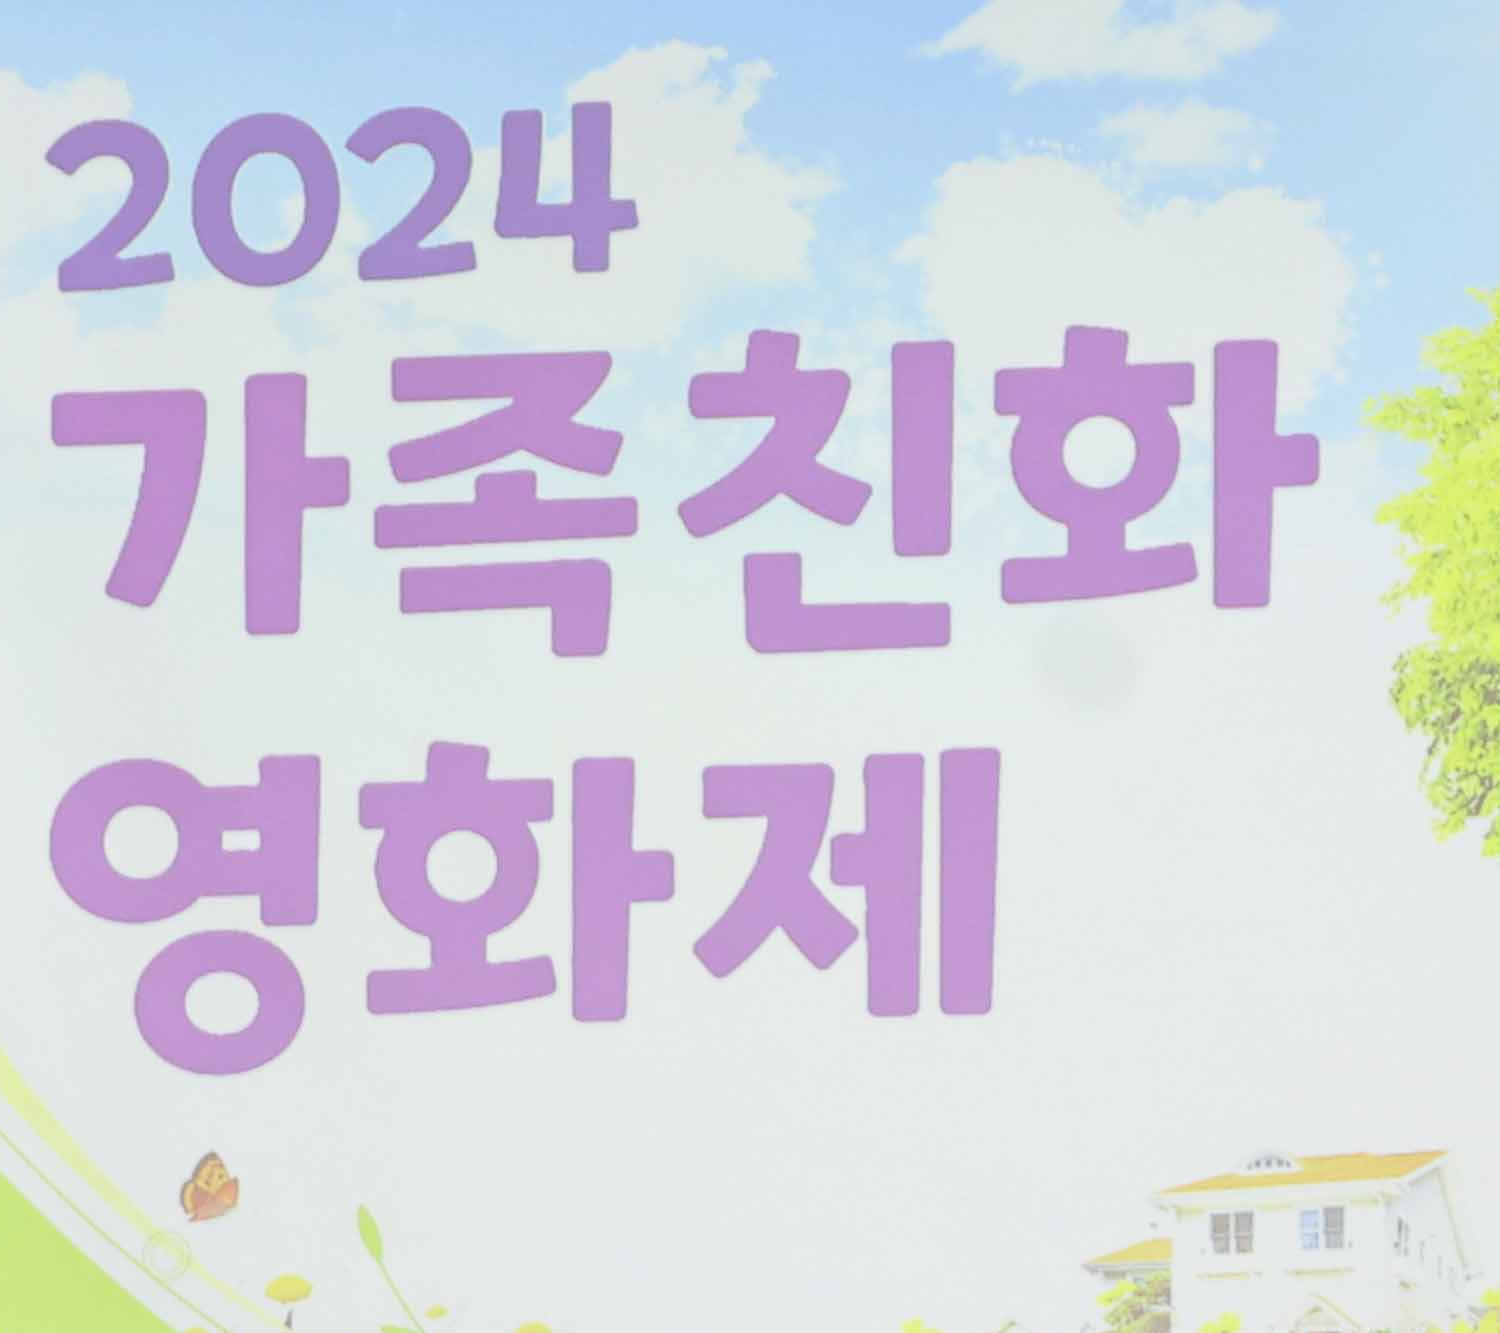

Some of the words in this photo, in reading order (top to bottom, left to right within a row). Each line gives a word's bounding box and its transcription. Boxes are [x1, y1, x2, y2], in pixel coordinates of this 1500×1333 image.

[45, 102, 639, 292] 2024
[50, 325, 1321, 658] 가족친화
[50, 742, 1001, 1076] 영화제
